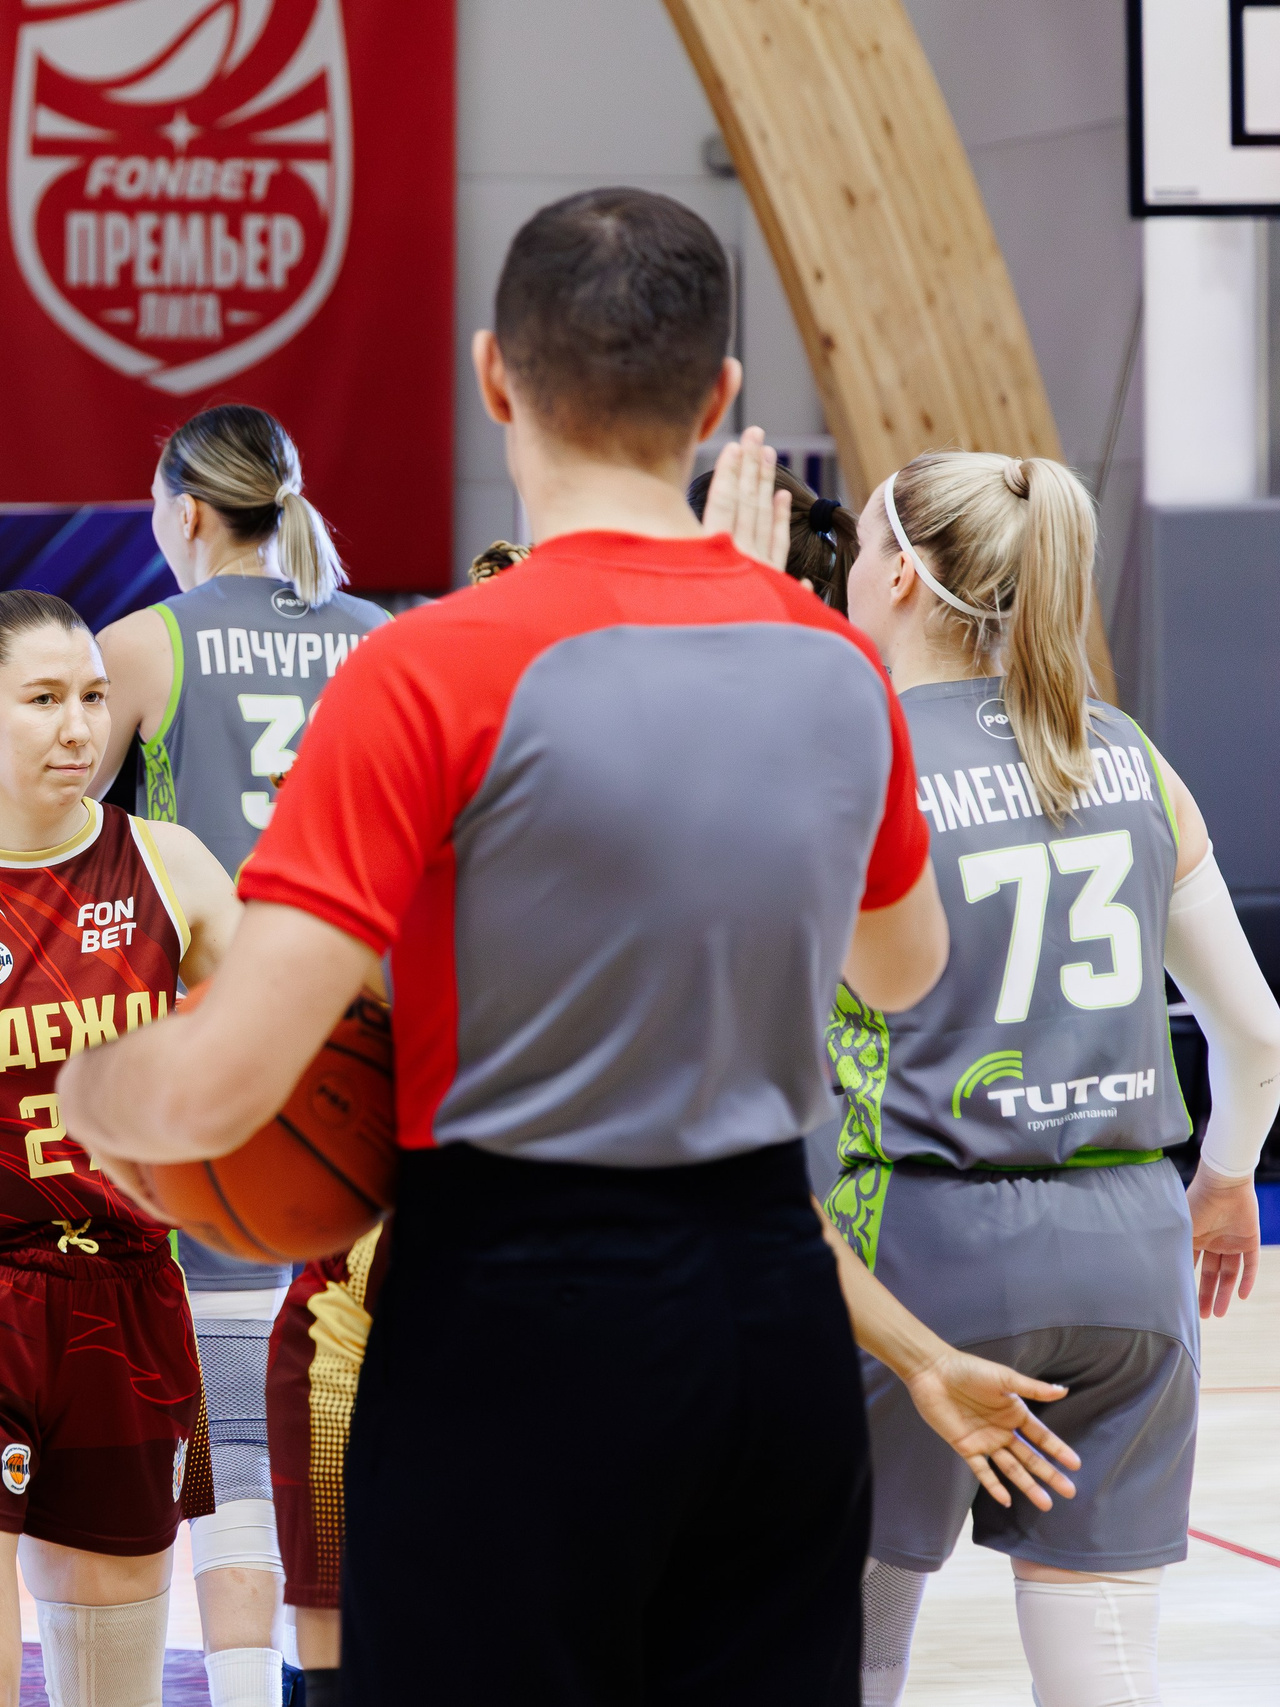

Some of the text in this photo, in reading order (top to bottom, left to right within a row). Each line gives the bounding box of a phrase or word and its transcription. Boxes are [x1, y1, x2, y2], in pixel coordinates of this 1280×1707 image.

[84, 156, 282, 200] FONBET
[65, 210, 305, 290] ПРЕМЬЕР
[196, 627, 370, 678] ПАЧУРИ
[77, 896, 134, 928] FON
[958, 829, 1143, 1025] 73
[81, 922, 137, 953] BET
